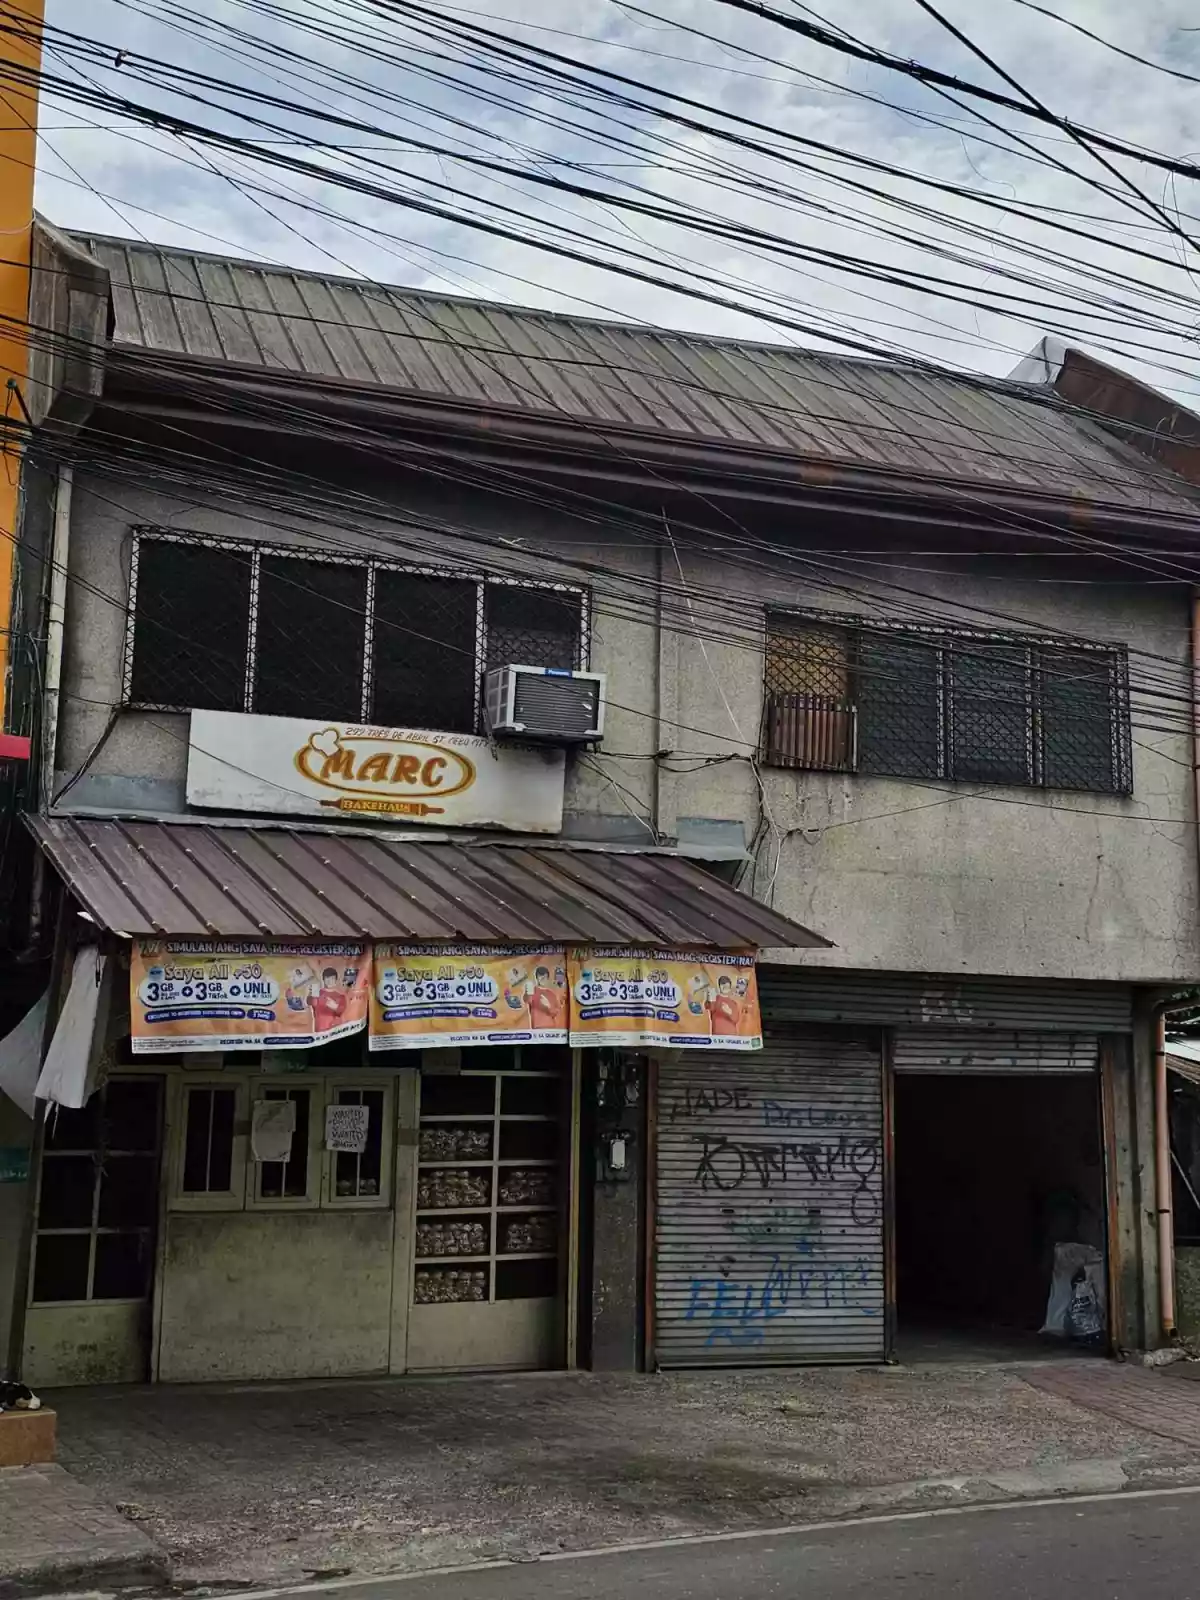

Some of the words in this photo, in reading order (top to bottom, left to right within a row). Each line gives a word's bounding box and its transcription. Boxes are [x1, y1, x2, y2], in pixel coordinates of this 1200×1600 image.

[368, 728, 389, 738] TRES
[392, 731, 404, 740] DE
[406, 732, 429, 742] ABRIL
[320, 749, 447, 788] MARC
[217, 942, 240, 953] ANG
[165, 964, 204, 984] Saya
[209, 964, 229, 980] All
[397, 967, 433, 986] Saya
[437, 966, 455, 980] All
[594, 968, 625, 985] Saya
[147, 982, 159, 1002] 3
[160, 983, 174, 992] GB
[195, 982, 207, 1001] 3
[208, 982, 222, 992] GB
[243, 982, 271, 994] UNLI
[384, 984, 394, 1001] 3
[395, 985, 406, 993] GB
[426, 983, 437, 1001] 3
[437, 983, 450, 992] GB
[468, 982, 492, 993] UNLI
[581, 984, 591, 1000] 3
[592, 984, 603, 992] GB
[619, 984, 628, 1000] 3
[628, 985, 639, 993] GB
[653, 987, 675, 997] UNLI
